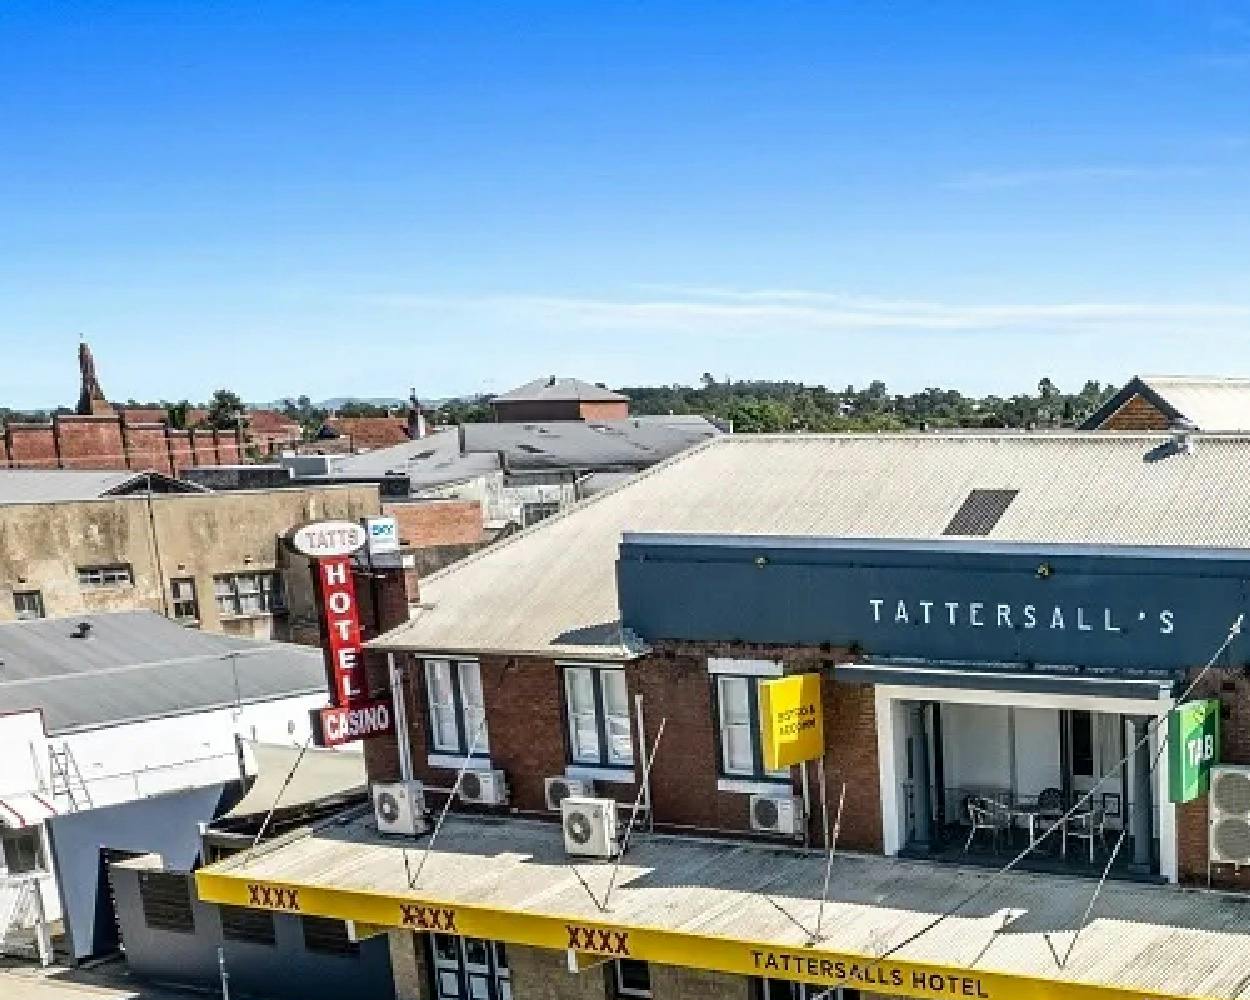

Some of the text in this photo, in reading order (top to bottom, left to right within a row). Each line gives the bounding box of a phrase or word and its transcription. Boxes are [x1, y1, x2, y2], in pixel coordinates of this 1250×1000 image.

[304, 528, 359, 549] TATTS
[325, 563, 360, 696] HOTEL
[869, 600, 1175, 634] TATTERSALL'S
[327, 705, 389, 740] CASINO
[1188, 735, 1214, 768] TAB
[248, 884, 300, 911] XXXX
[400, 904, 458, 933] XXXX
[565, 925, 631, 956] XXXX
[751, 950, 989, 999] TATTERSALLS HOTEL
